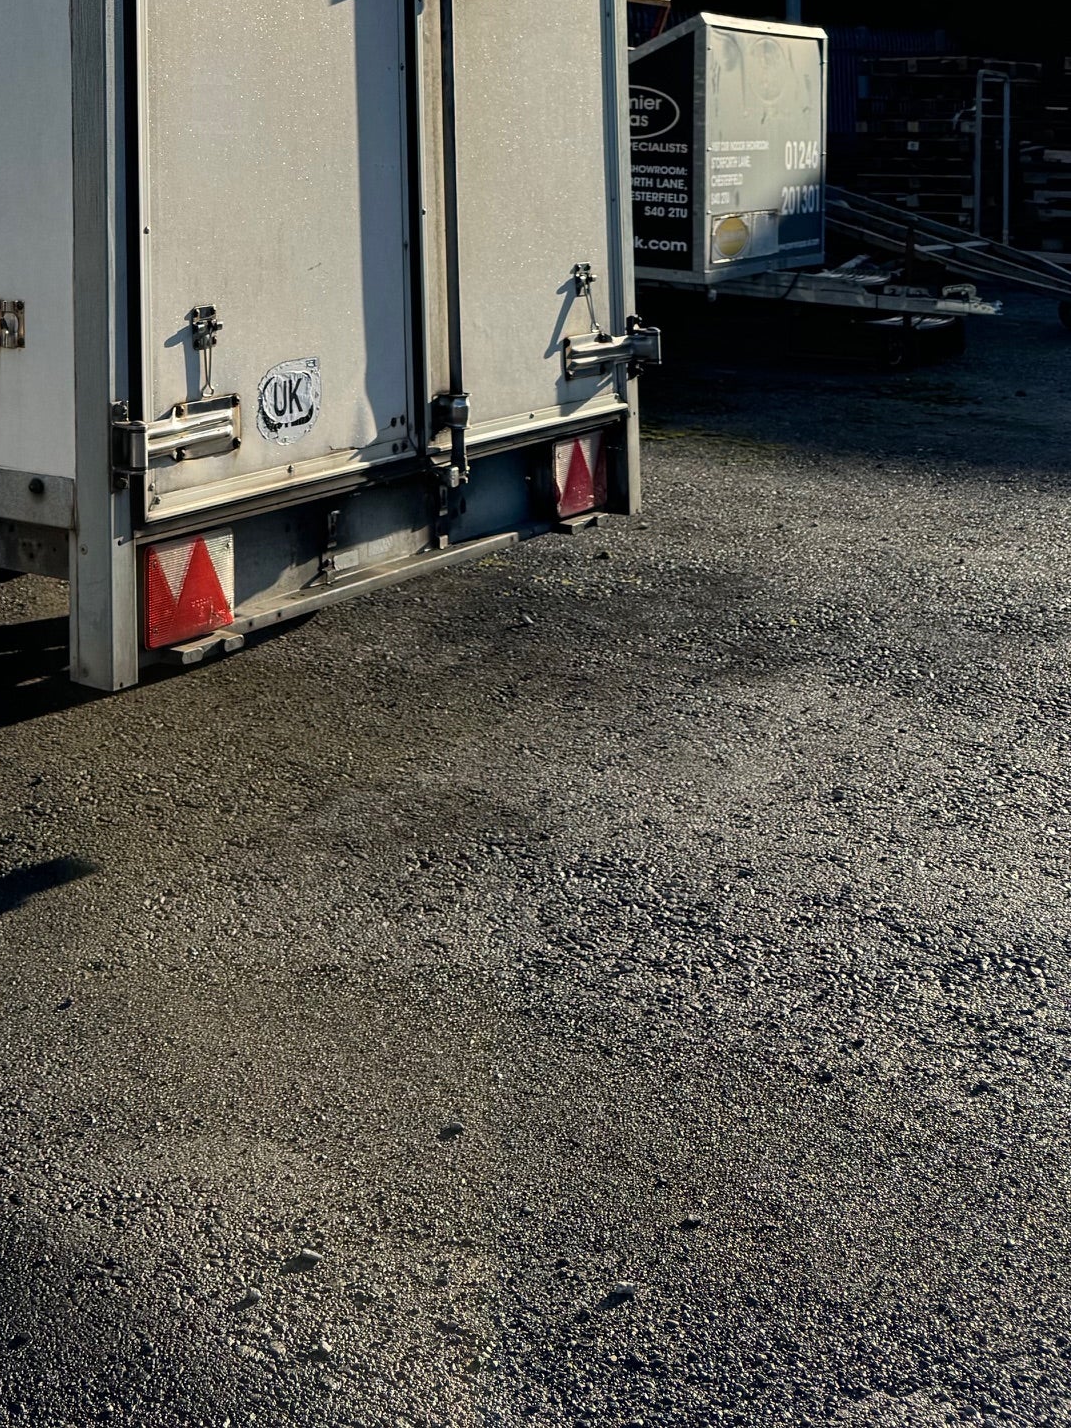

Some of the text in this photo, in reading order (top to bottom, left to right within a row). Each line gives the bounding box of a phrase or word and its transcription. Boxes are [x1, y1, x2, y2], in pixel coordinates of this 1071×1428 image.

[630, 141, 688, 154] ECIALISTS
[784, 140, 818, 170] 01246
[631, 177, 688, 191] RTH LANE,
[781, 184, 820, 216] 201301
[644, 206, 688, 219] S40 2TU
[634, 235, 687, 252] k.com
[274, 377, 303, 416] UK
